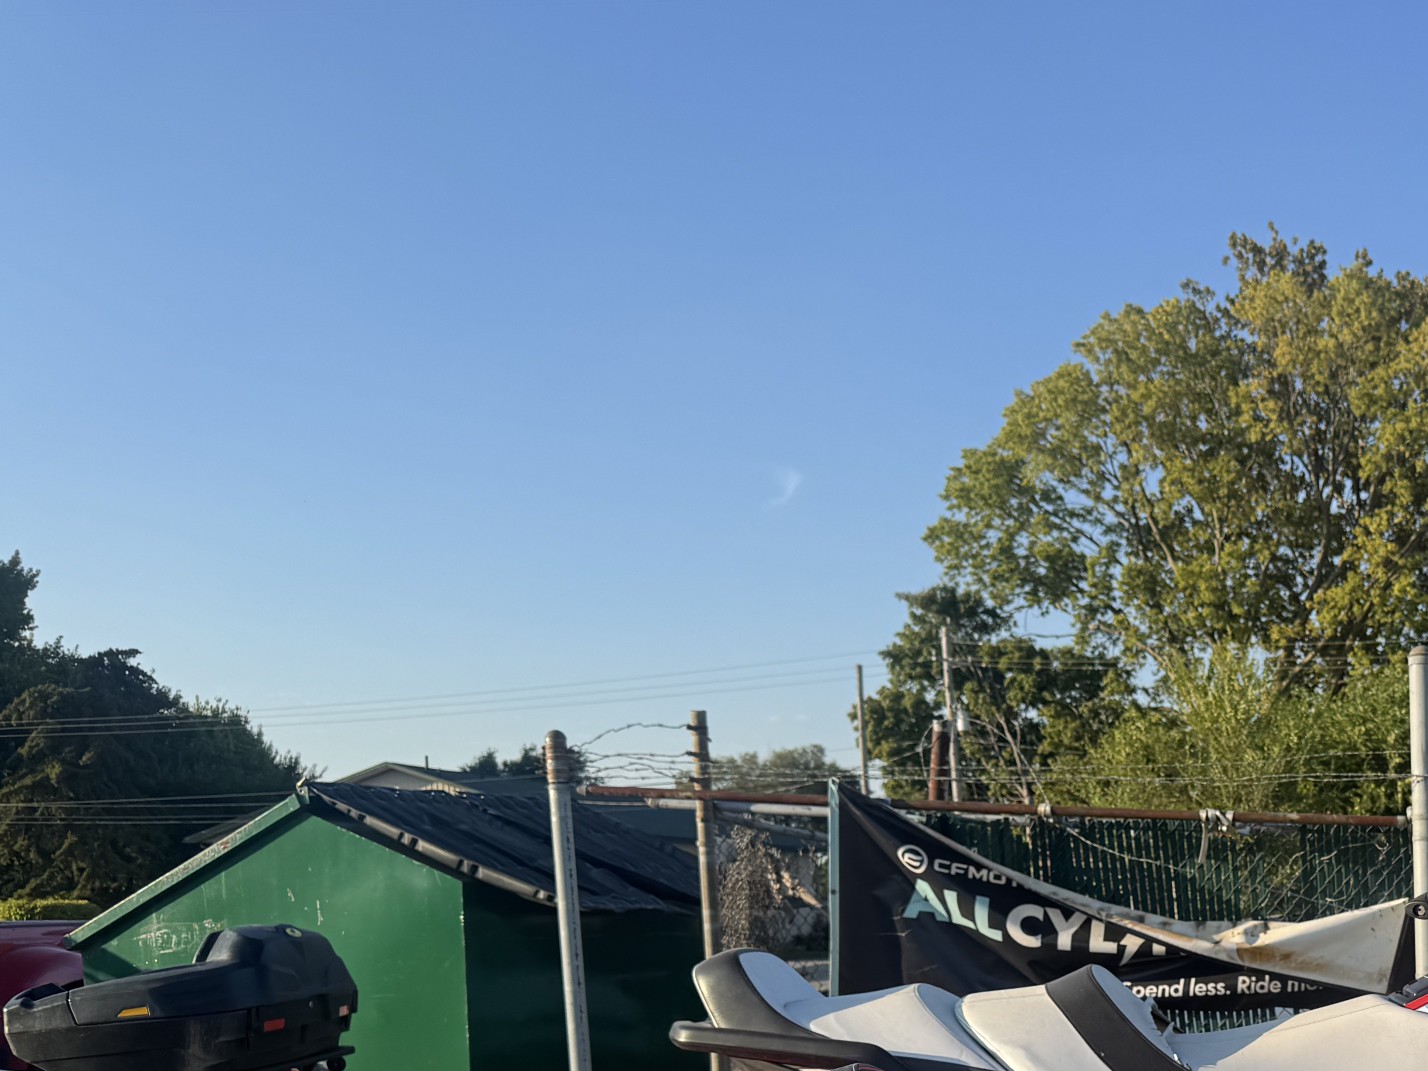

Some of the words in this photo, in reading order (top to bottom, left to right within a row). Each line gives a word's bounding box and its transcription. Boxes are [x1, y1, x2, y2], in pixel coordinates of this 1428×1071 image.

[933, 858, 1018, 888] CFMO
[902, 878, 1004, 943] ALL
[1188, 977, 1231, 998] less.
[1237, 974, 1282, 995] Ride
